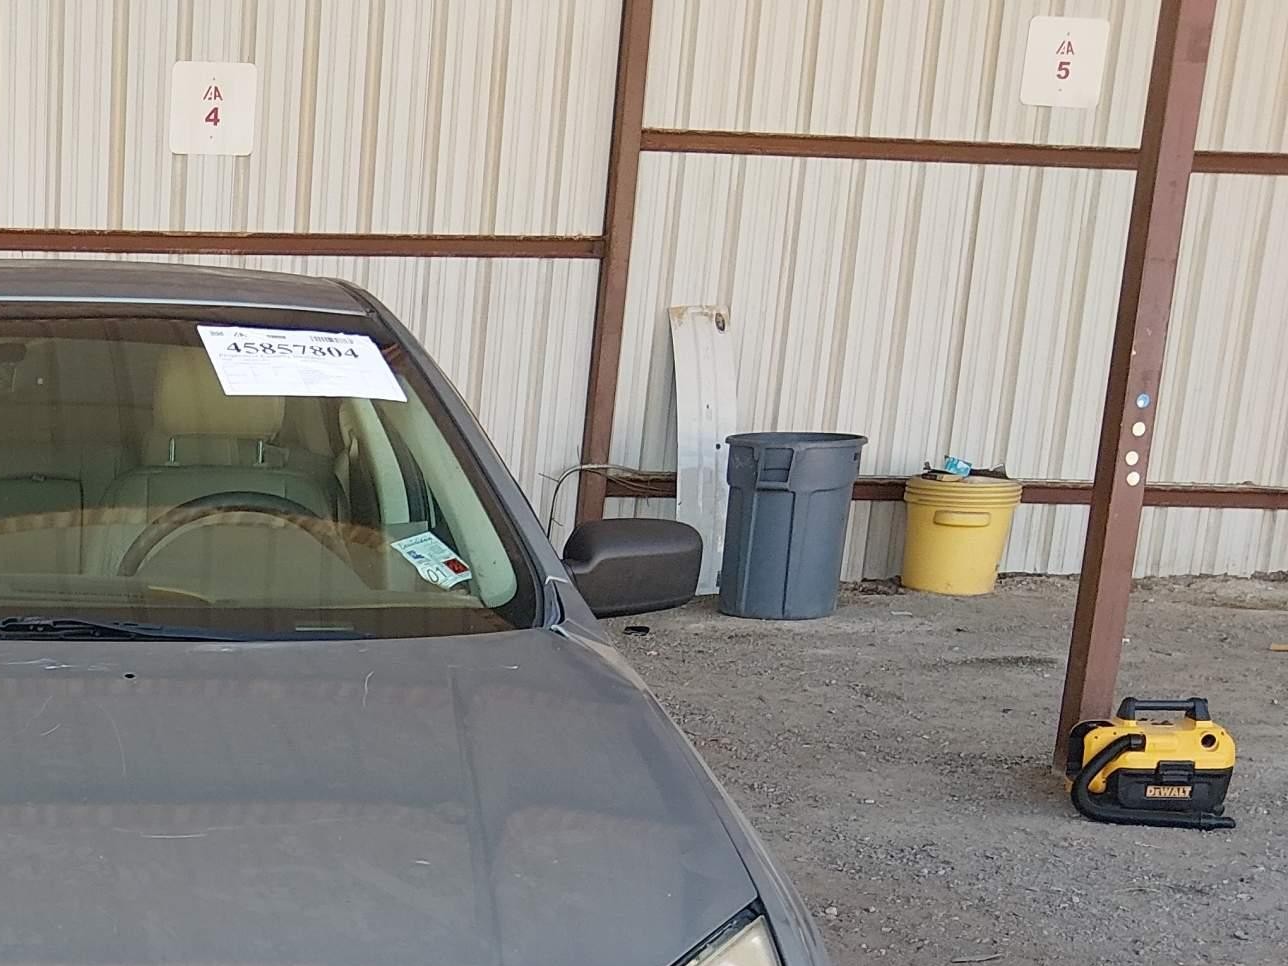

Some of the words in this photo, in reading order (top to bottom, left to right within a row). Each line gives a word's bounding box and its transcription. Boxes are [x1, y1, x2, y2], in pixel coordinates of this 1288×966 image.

[1056, 61, 1071, 80] 5
[204, 106, 221, 127] 4
[226, 341, 360, 359] 45857804
